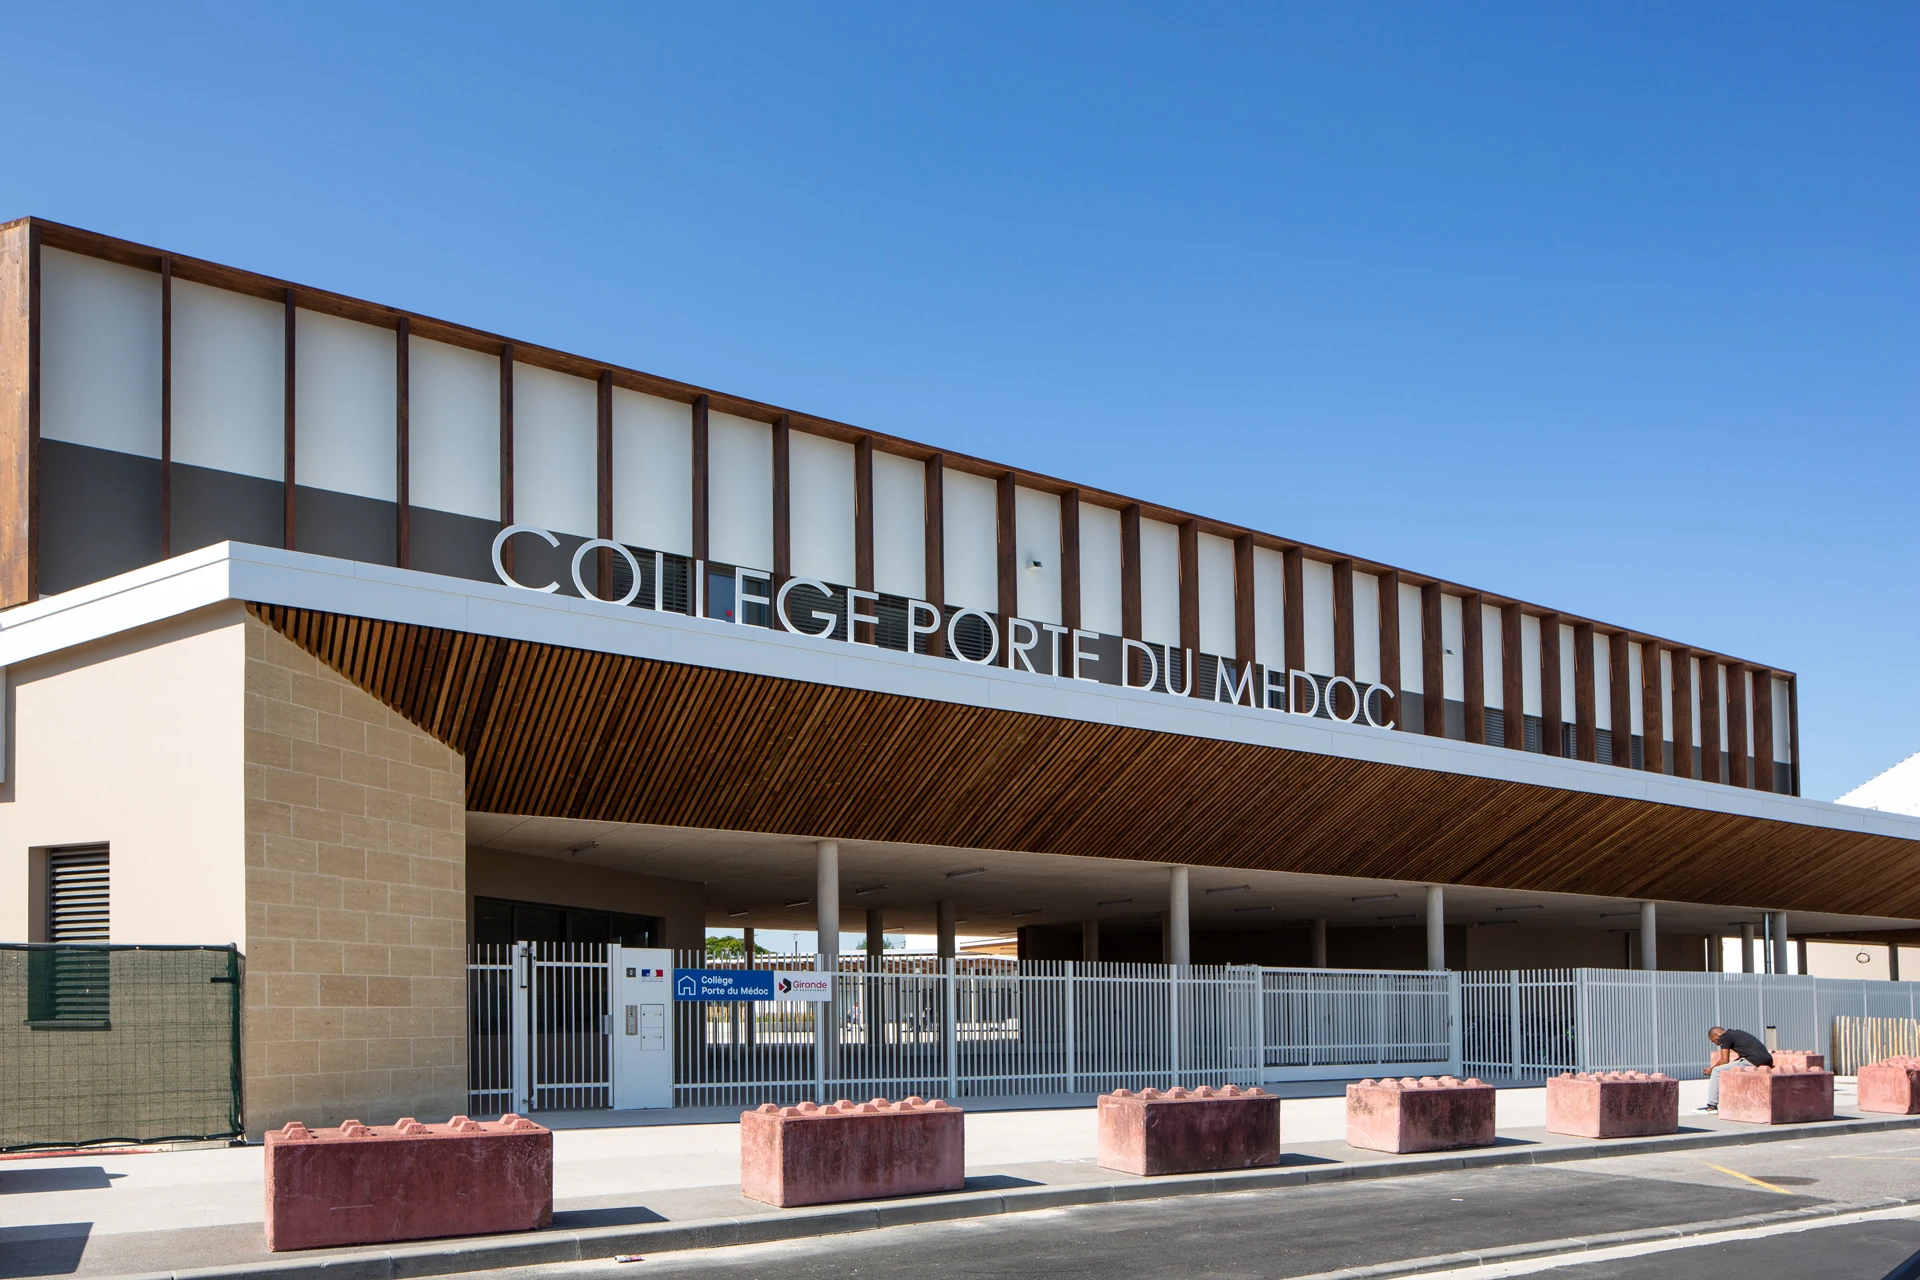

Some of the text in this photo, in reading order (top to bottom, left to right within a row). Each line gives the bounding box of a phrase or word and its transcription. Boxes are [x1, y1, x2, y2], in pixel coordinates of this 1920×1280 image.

[491, 524, 1395, 731] COLLEGE PORTE DU MEDOC
[701, 976, 733, 986] Collège
[793, 980, 827, 988] Gironde
[701, 986, 769, 995] Porte du Médoc
